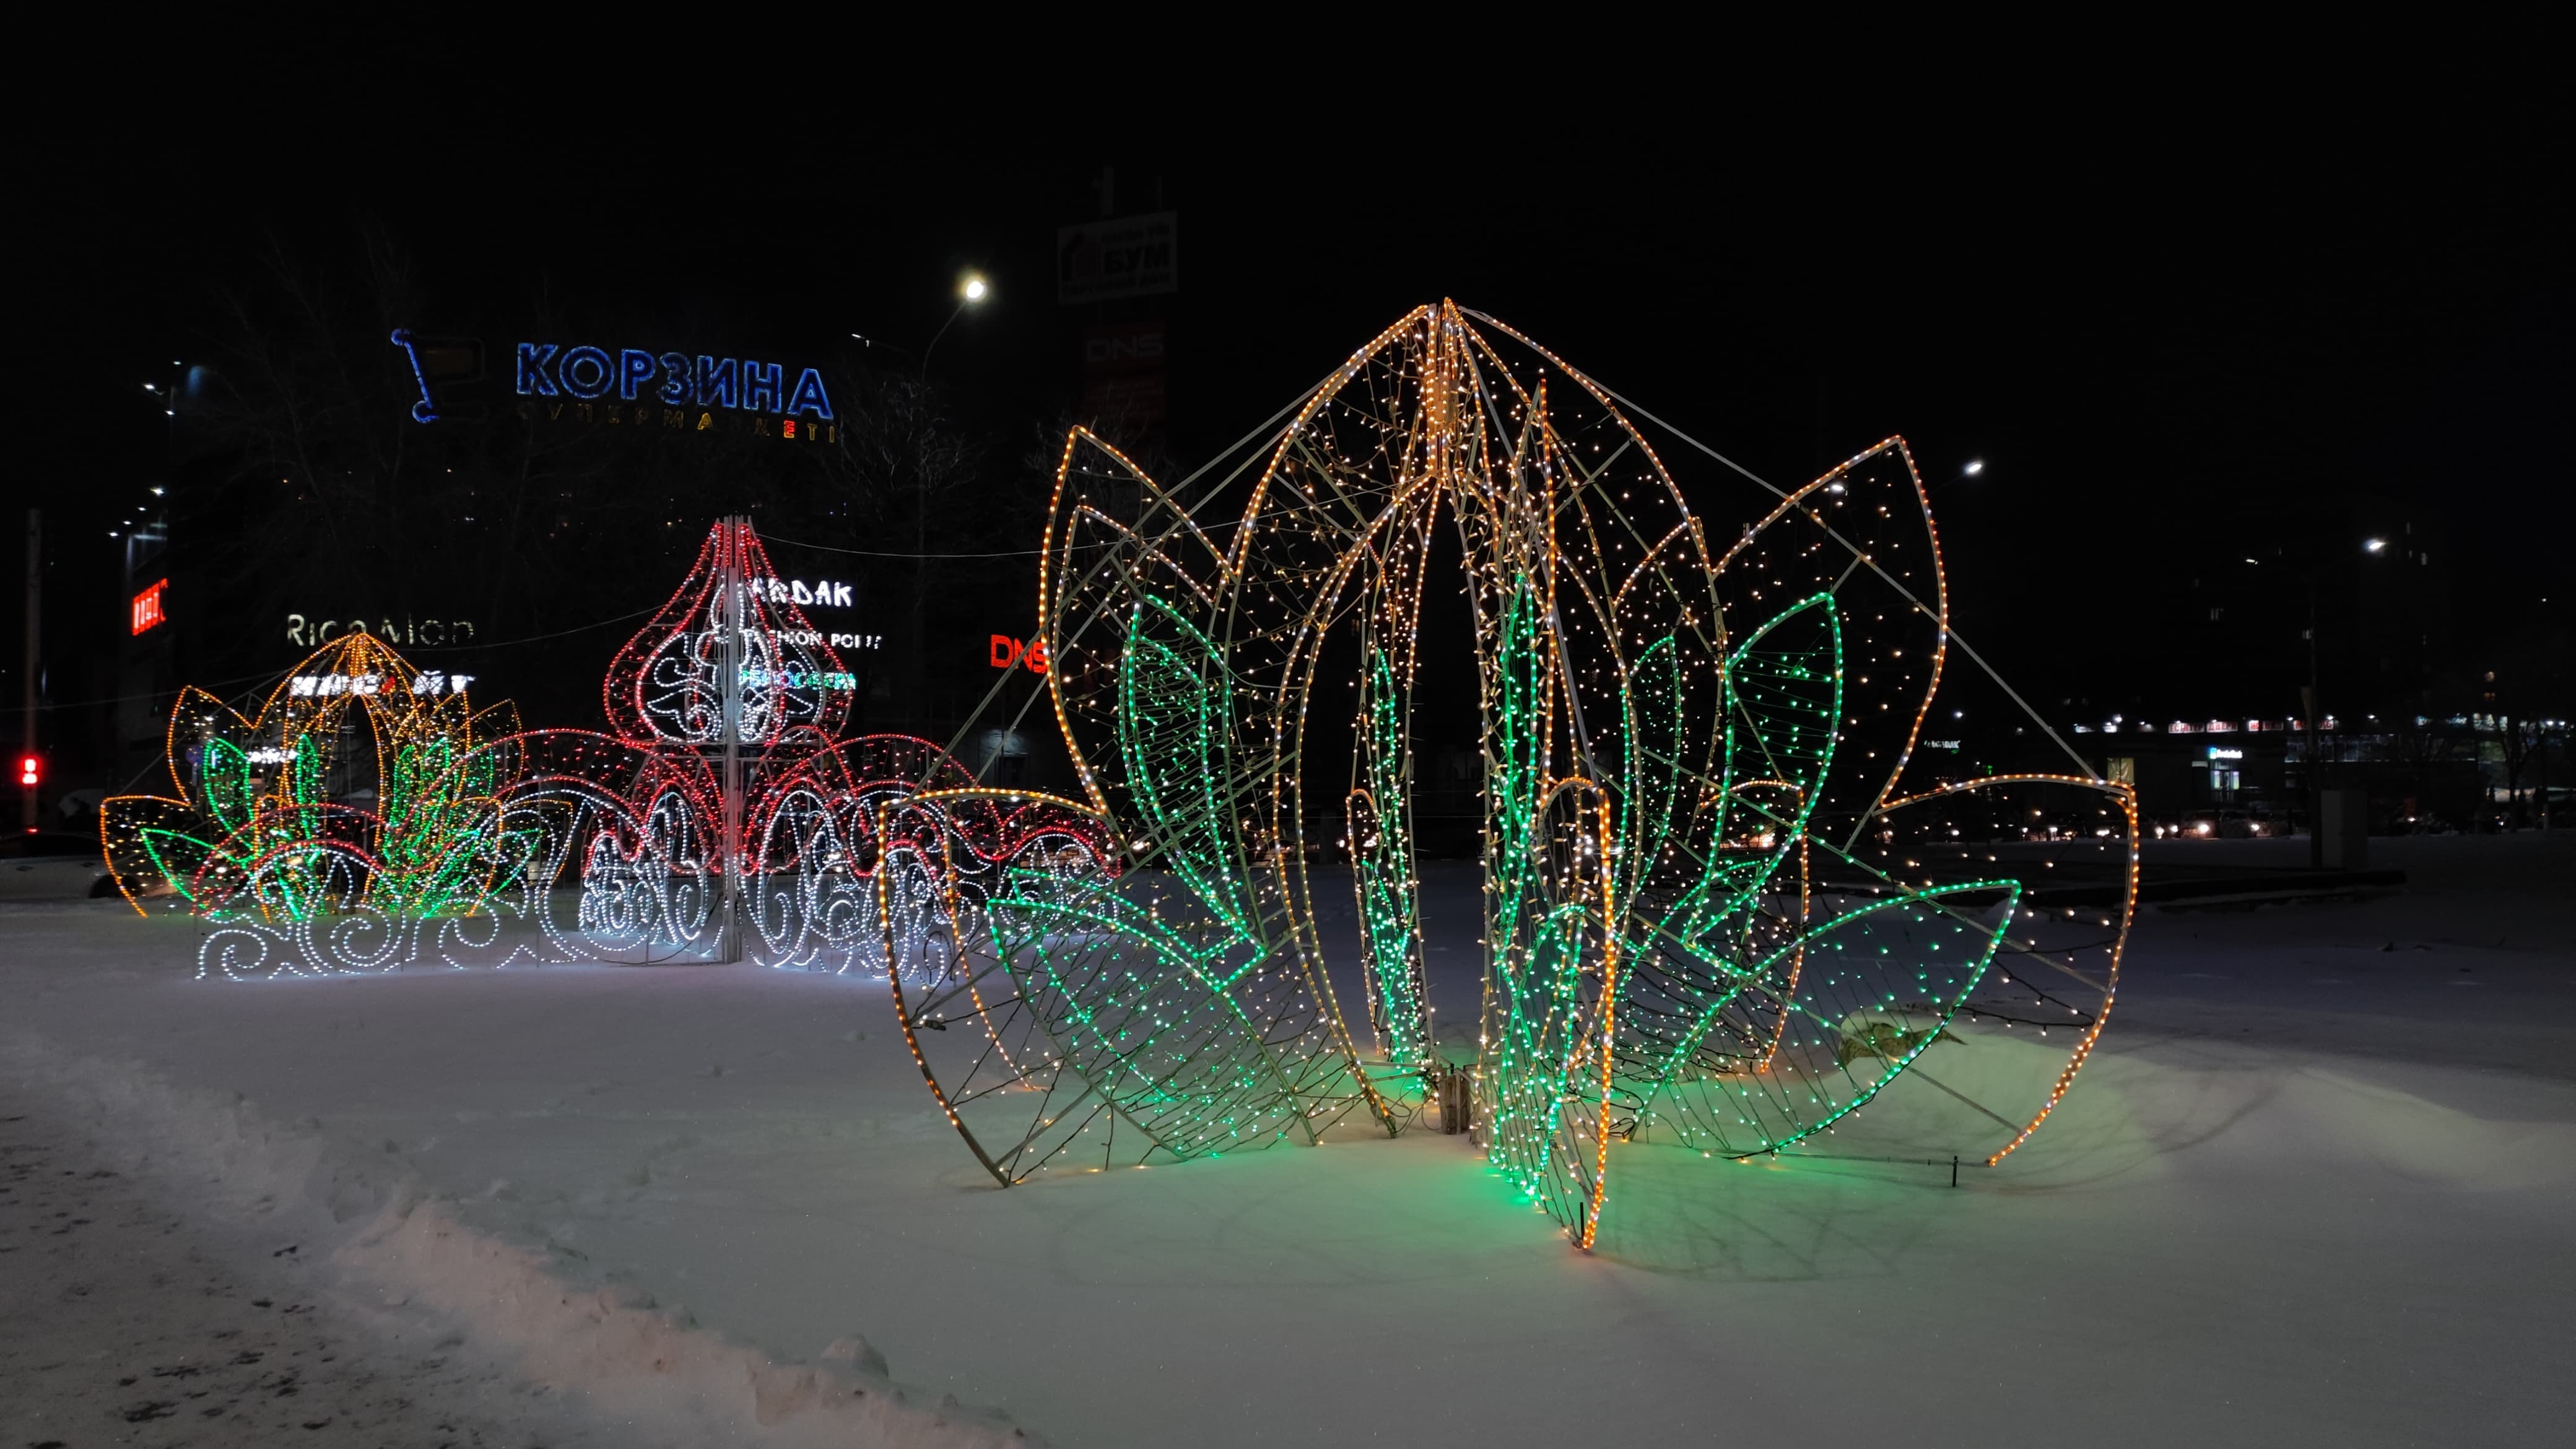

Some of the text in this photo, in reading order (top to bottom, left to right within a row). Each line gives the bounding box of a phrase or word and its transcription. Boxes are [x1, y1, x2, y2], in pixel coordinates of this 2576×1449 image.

[1105, 242, 1170, 274] БУМ
[1086, 332, 1164, 363] DNS
[516, 342, 835, 420] КОРЗИНА
[991, 634, 1047, 674] DNS
